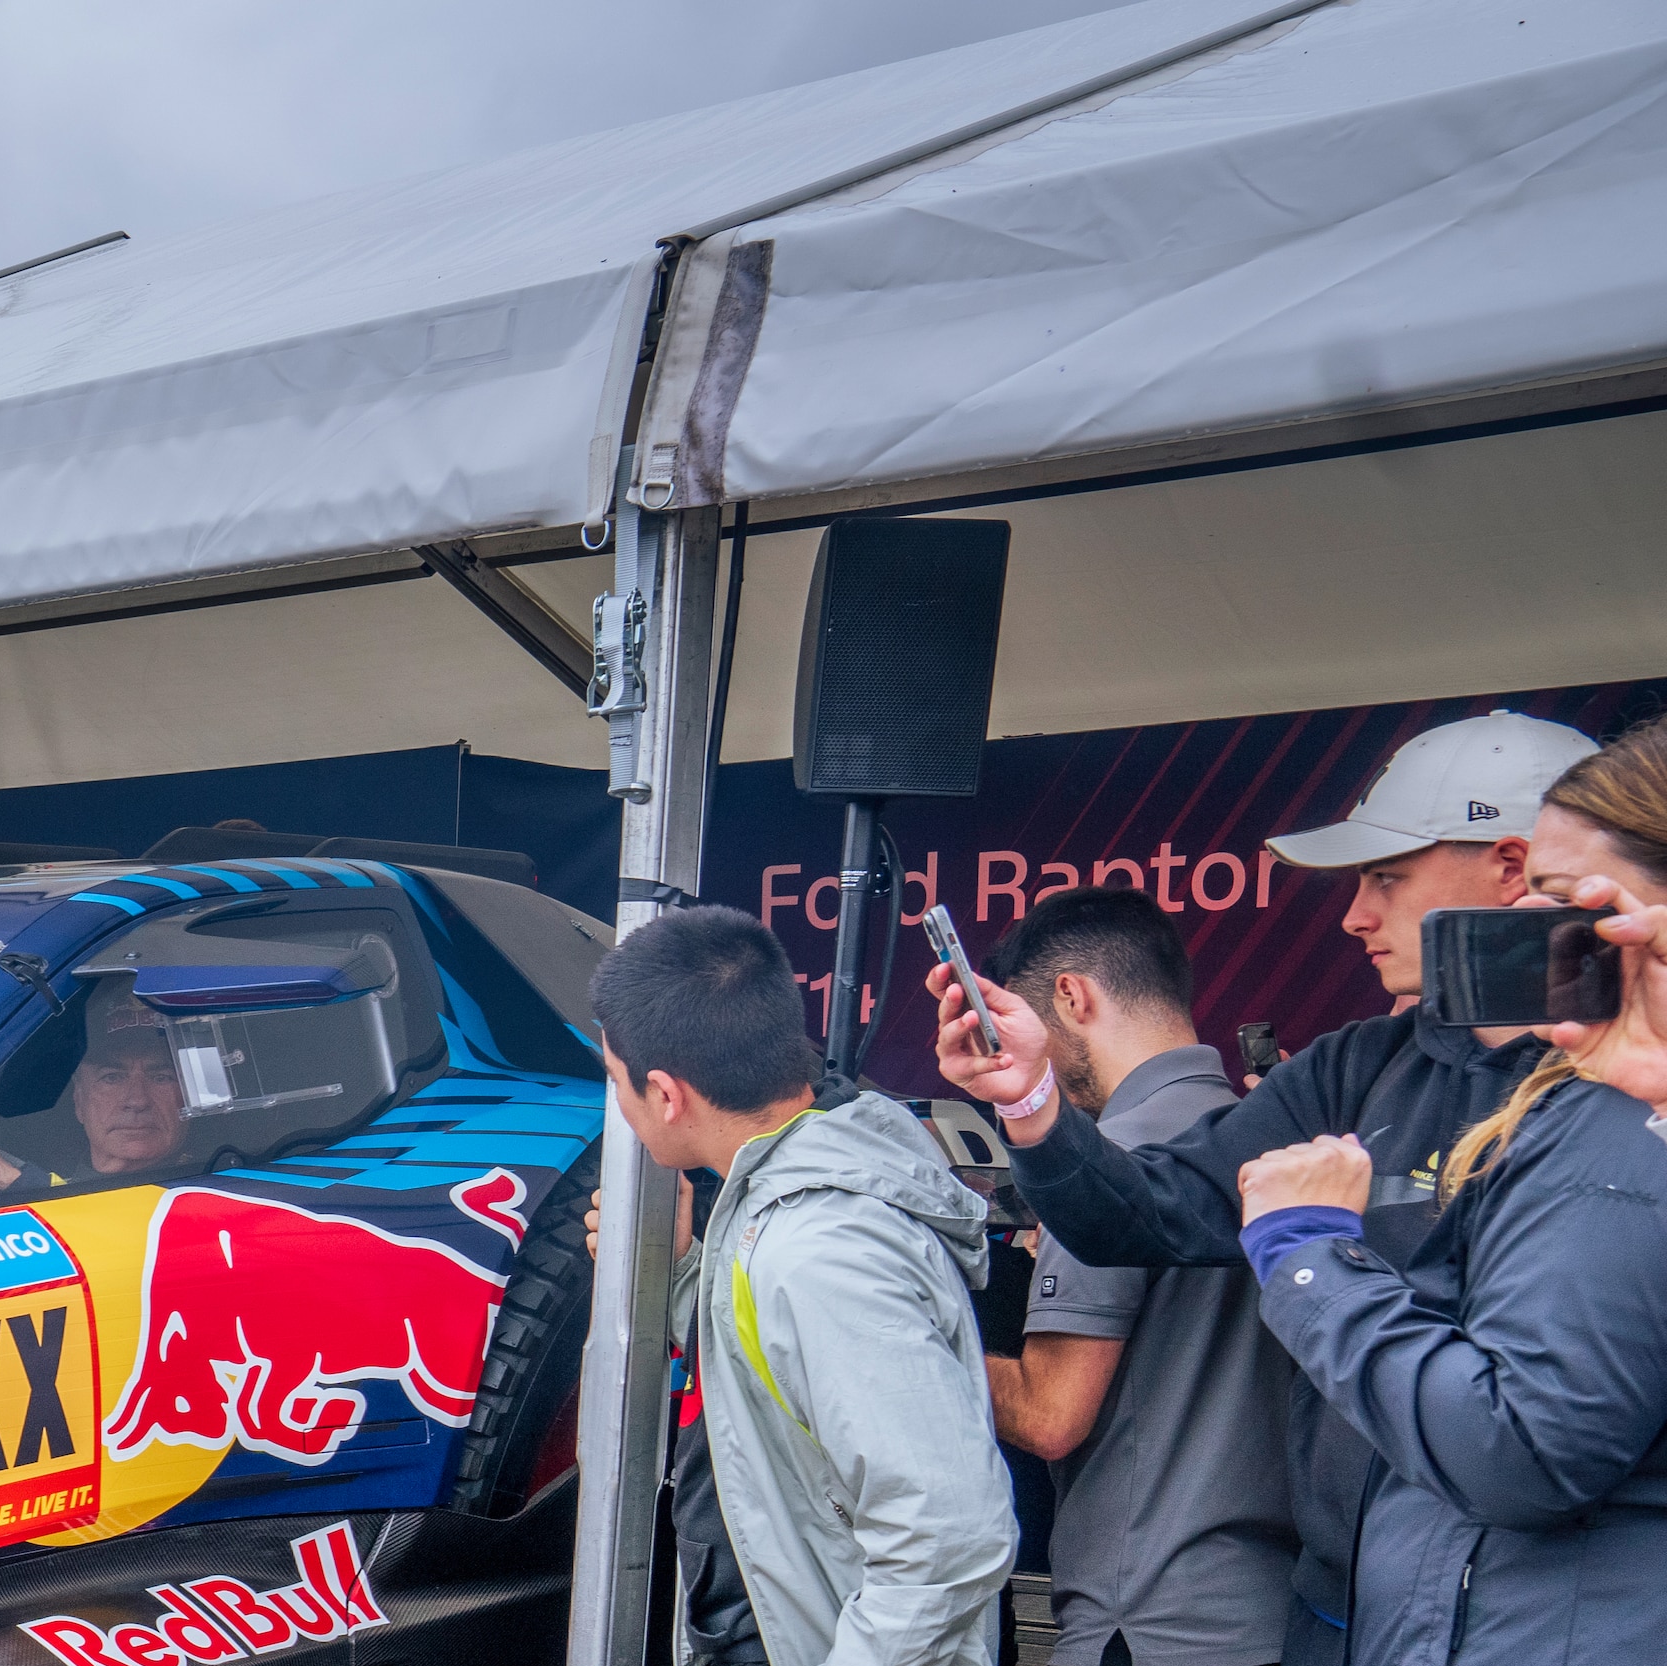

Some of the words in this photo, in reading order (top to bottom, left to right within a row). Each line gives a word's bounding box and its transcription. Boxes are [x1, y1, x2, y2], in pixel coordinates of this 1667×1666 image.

[20, 1490, 70, 1520] LIVE
[70, 1485, 94, 1507] IT.
[180, 1519, 390, 1655] Bull
